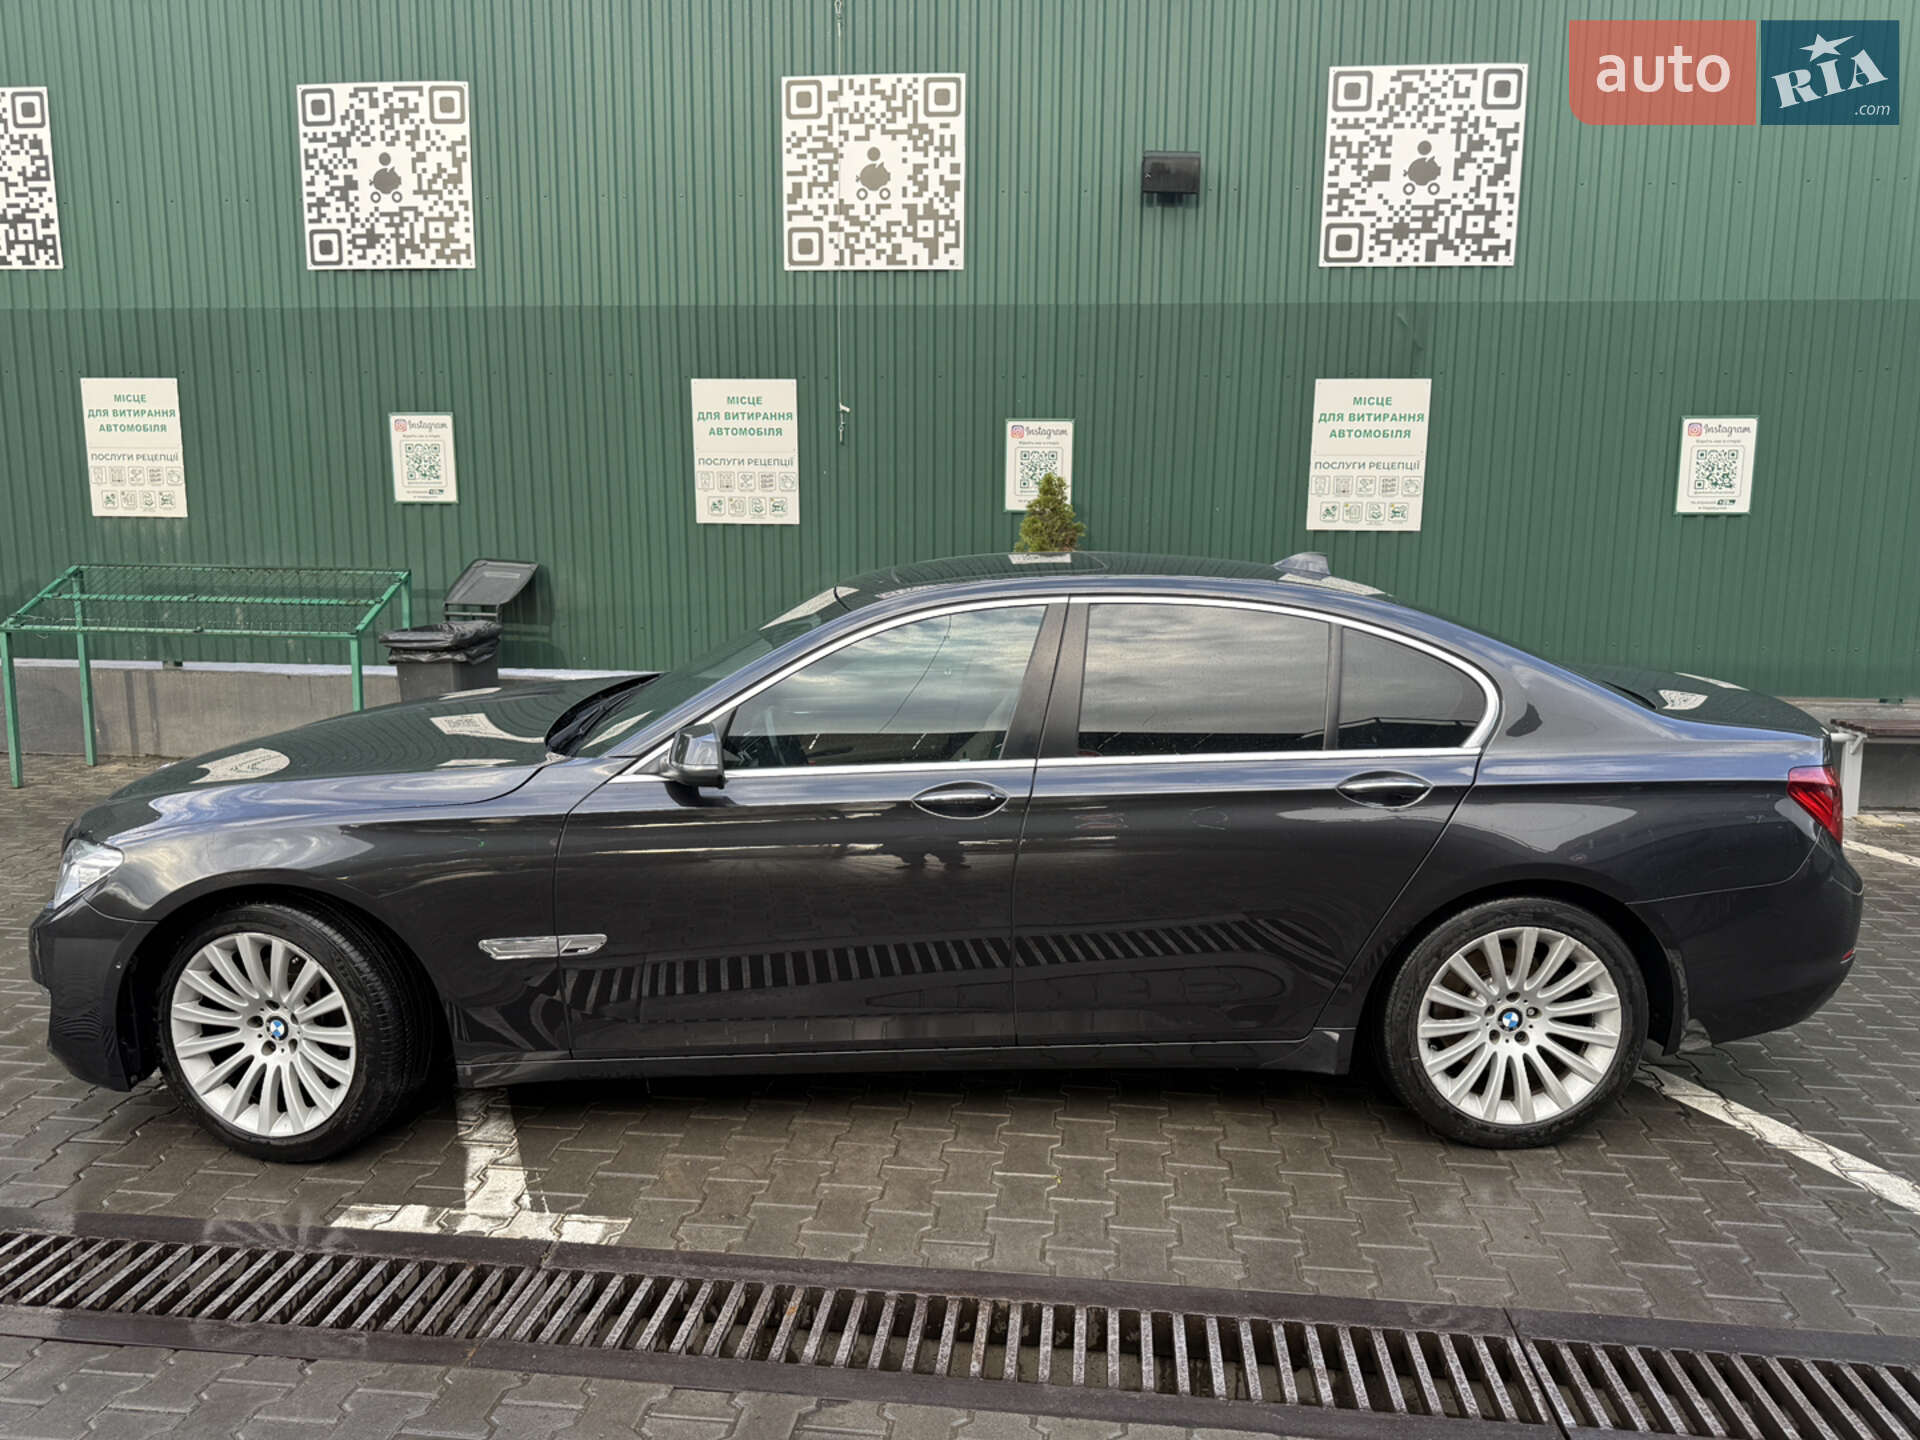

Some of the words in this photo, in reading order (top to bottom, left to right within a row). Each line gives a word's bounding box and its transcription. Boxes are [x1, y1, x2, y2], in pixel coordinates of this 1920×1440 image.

[113, 394, 147, 404] МІСЦЕ
[727, 396, 763, 406] МІСЦЕ
[1352, 396, 1392, 407] МІСЦЕ
[87, 408, 109, 419] ДЛЯ
[112, 408, 176, 418] ВИТИРАННЯ
[697, 411, 720, 422] ДЛЯ
[724, 411, 793, 421] ВИТИРАННЯ
[1318, 412, 1344, 424] ДЛЯ
[1348, 412, 1425, 423] ВИТИРАННЯ
[98, 423, 168, 433] АВТОМОБІЛЯ
[407, 419, 449, 433] Instagram
[1703, 423, 1752, 438] Instagram
[708, 427, 783, 437] АВТОМОБІЛЯ
[1025, 425, 1068, 440] Instagram
[1329, 428, 1411, 439] АВТОМОБІЛЯ
[90, 452, 134, 462] ПОСЛУГИ
[135, 451, 179, 463] РЕЦЕПЦІЇ
[698, 457, 745, 467] ПОСЛУГИ
[747, 456, 794, 467] РЕЦЕПЦІЇ
[1314, 460, 1366, 470] ПОСЛУГИ
[1368, 459, 1420, 471] РЕЦЕПЦІЇ
